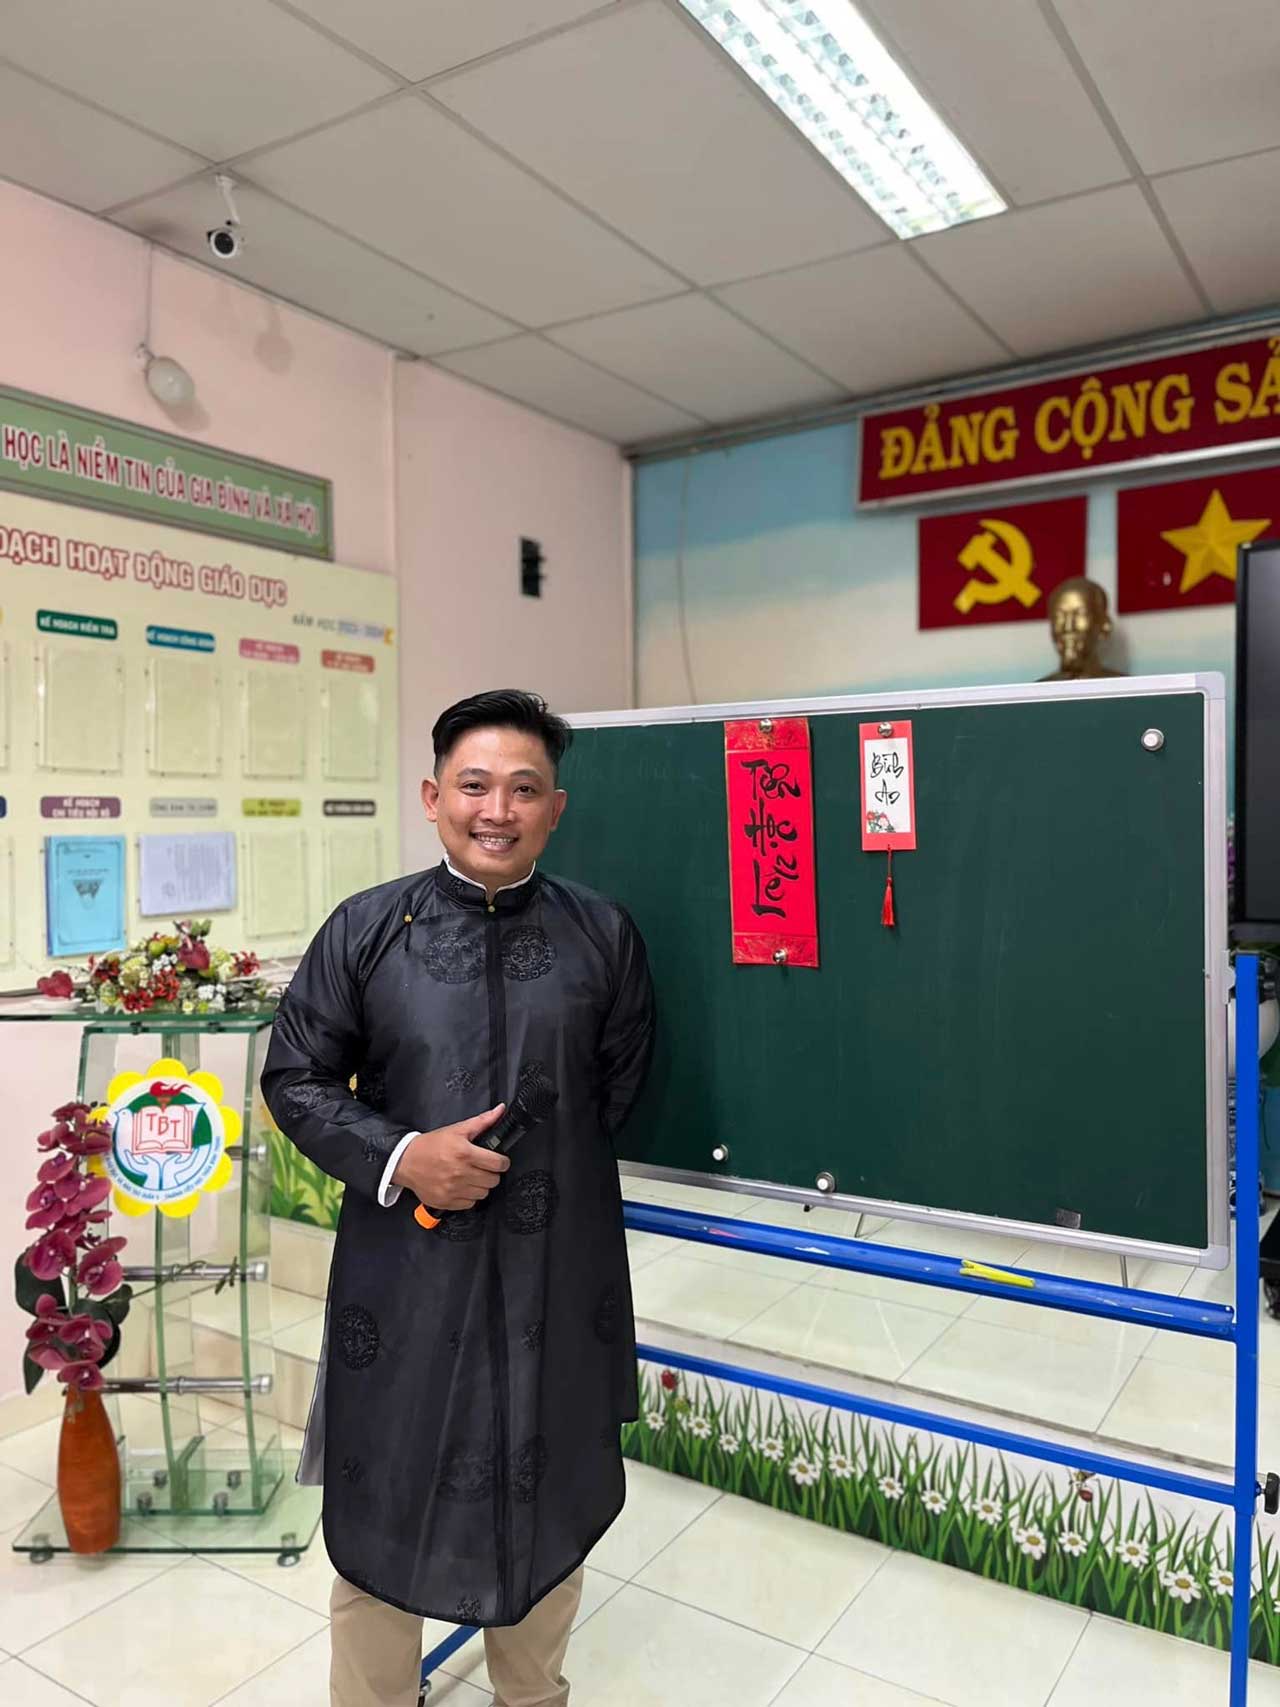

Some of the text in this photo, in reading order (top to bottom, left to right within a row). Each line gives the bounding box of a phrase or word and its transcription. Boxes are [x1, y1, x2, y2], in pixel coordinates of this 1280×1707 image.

[879, 403, 1019, 480] ĐẢNG
[1034, 376, 1195, 460] CỘNG
[3, 424, 43, 470] HỌC
[47, 430, 72, 473] LÀ
[75, 436, 121, 486] NIỀM
[124, 456, 152, 493] TIN
[155, 457, 187, 502] CỦA
[189, 474, 214, 509] GIA
[216, 476, 252, 518] ĐÌNH
[66, 539, 129, 580] HOẠT
[134, 550, 193, 589] ĐỘNG
[199, 564, 245, 598] GIÁO
[249, 575, 288, 608] DỤC
[744, 797, 797, 856] Học
[146, 1113, 181, 1138] TBT
